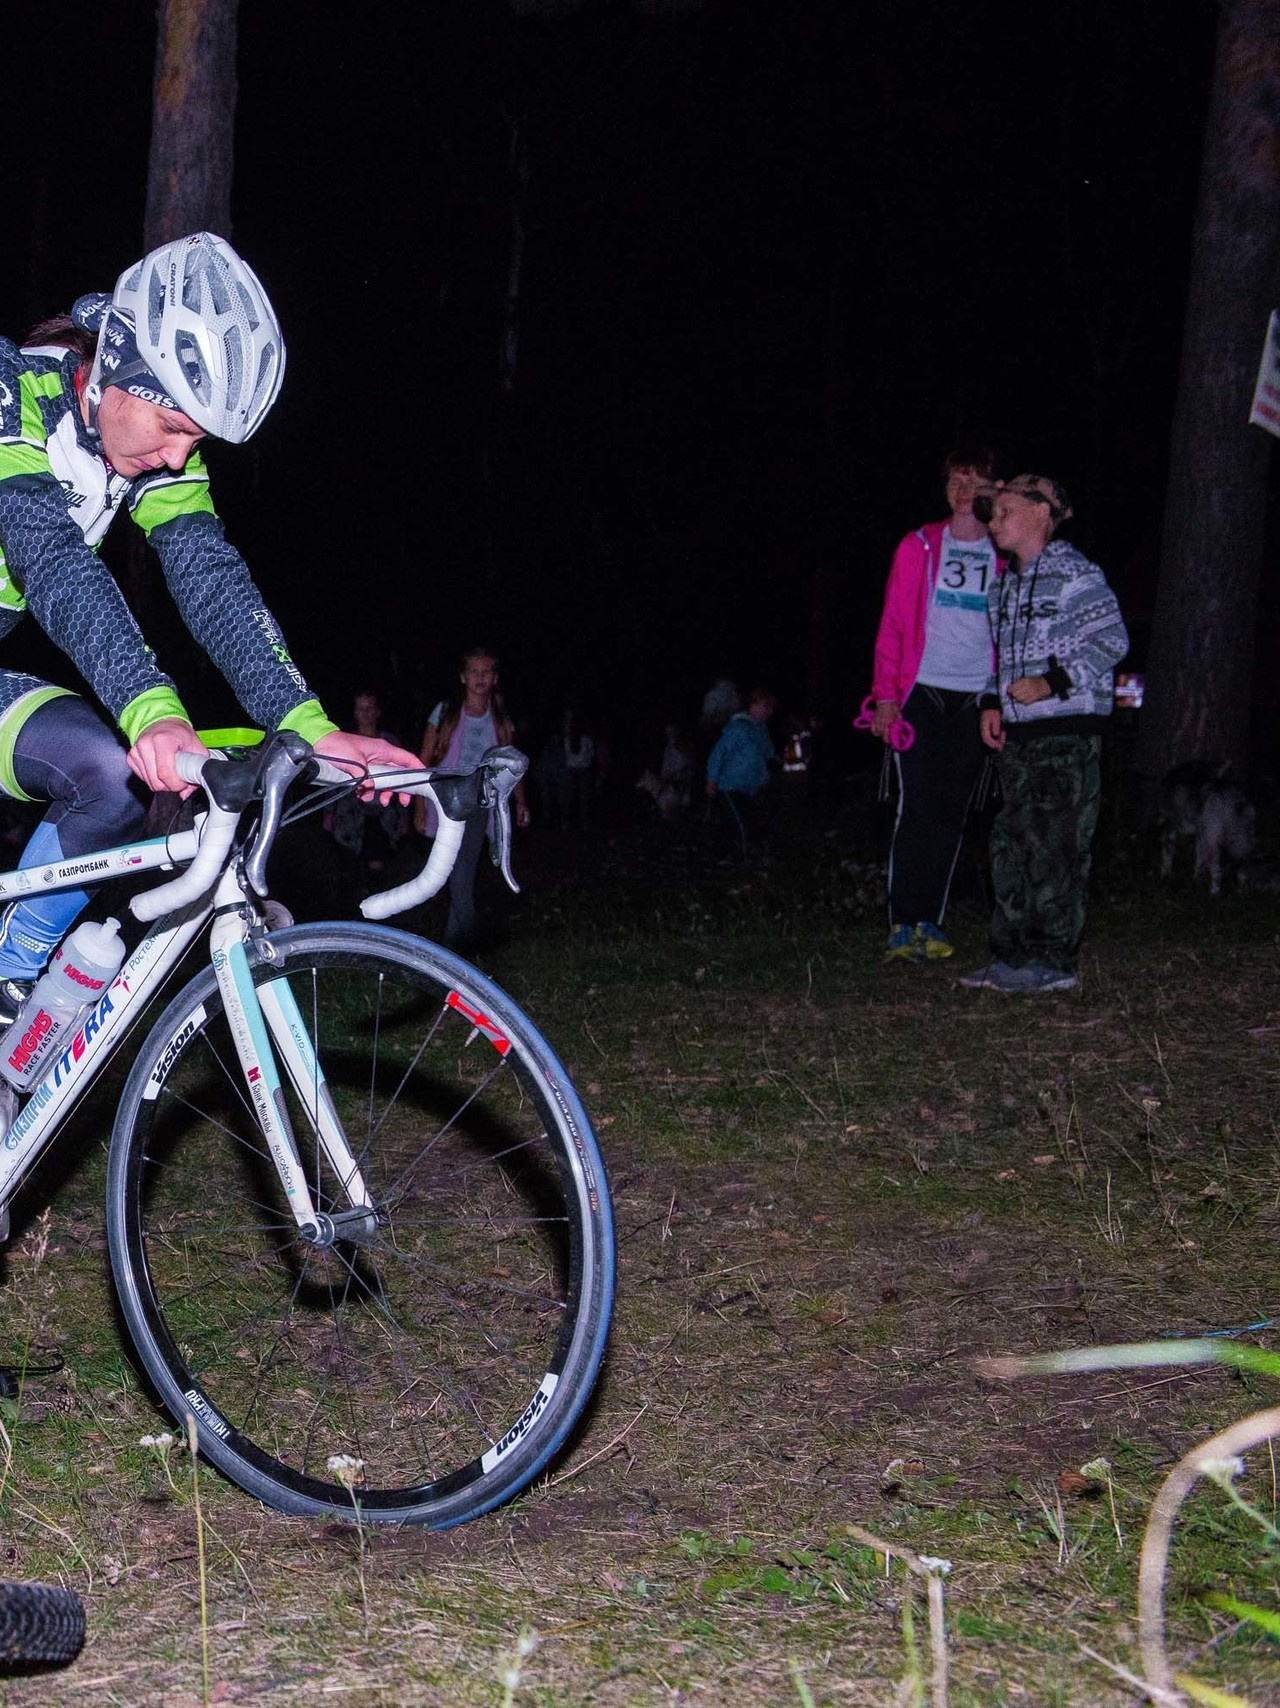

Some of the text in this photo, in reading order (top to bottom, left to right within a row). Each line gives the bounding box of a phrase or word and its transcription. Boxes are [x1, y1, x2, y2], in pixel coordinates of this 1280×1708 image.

[169, 262, 177, 307] CRATONI
[942, 560, 988, 592] 31
[58, 859, 110, 878] ГАЗПРОМБАНК
[63, 964, 105, 990] HIGH5
[8, 1009, 53, 1073] HIGH5
[23, 1021, 62, 1076] RACE FASTER
[54, 993, 115, 1088] ITERA
[151, 1020, 195, 1084] Vision
[251, 1083, 272, 1134] Банк Москвы
[496, 1390, 549, 1456] Vision
